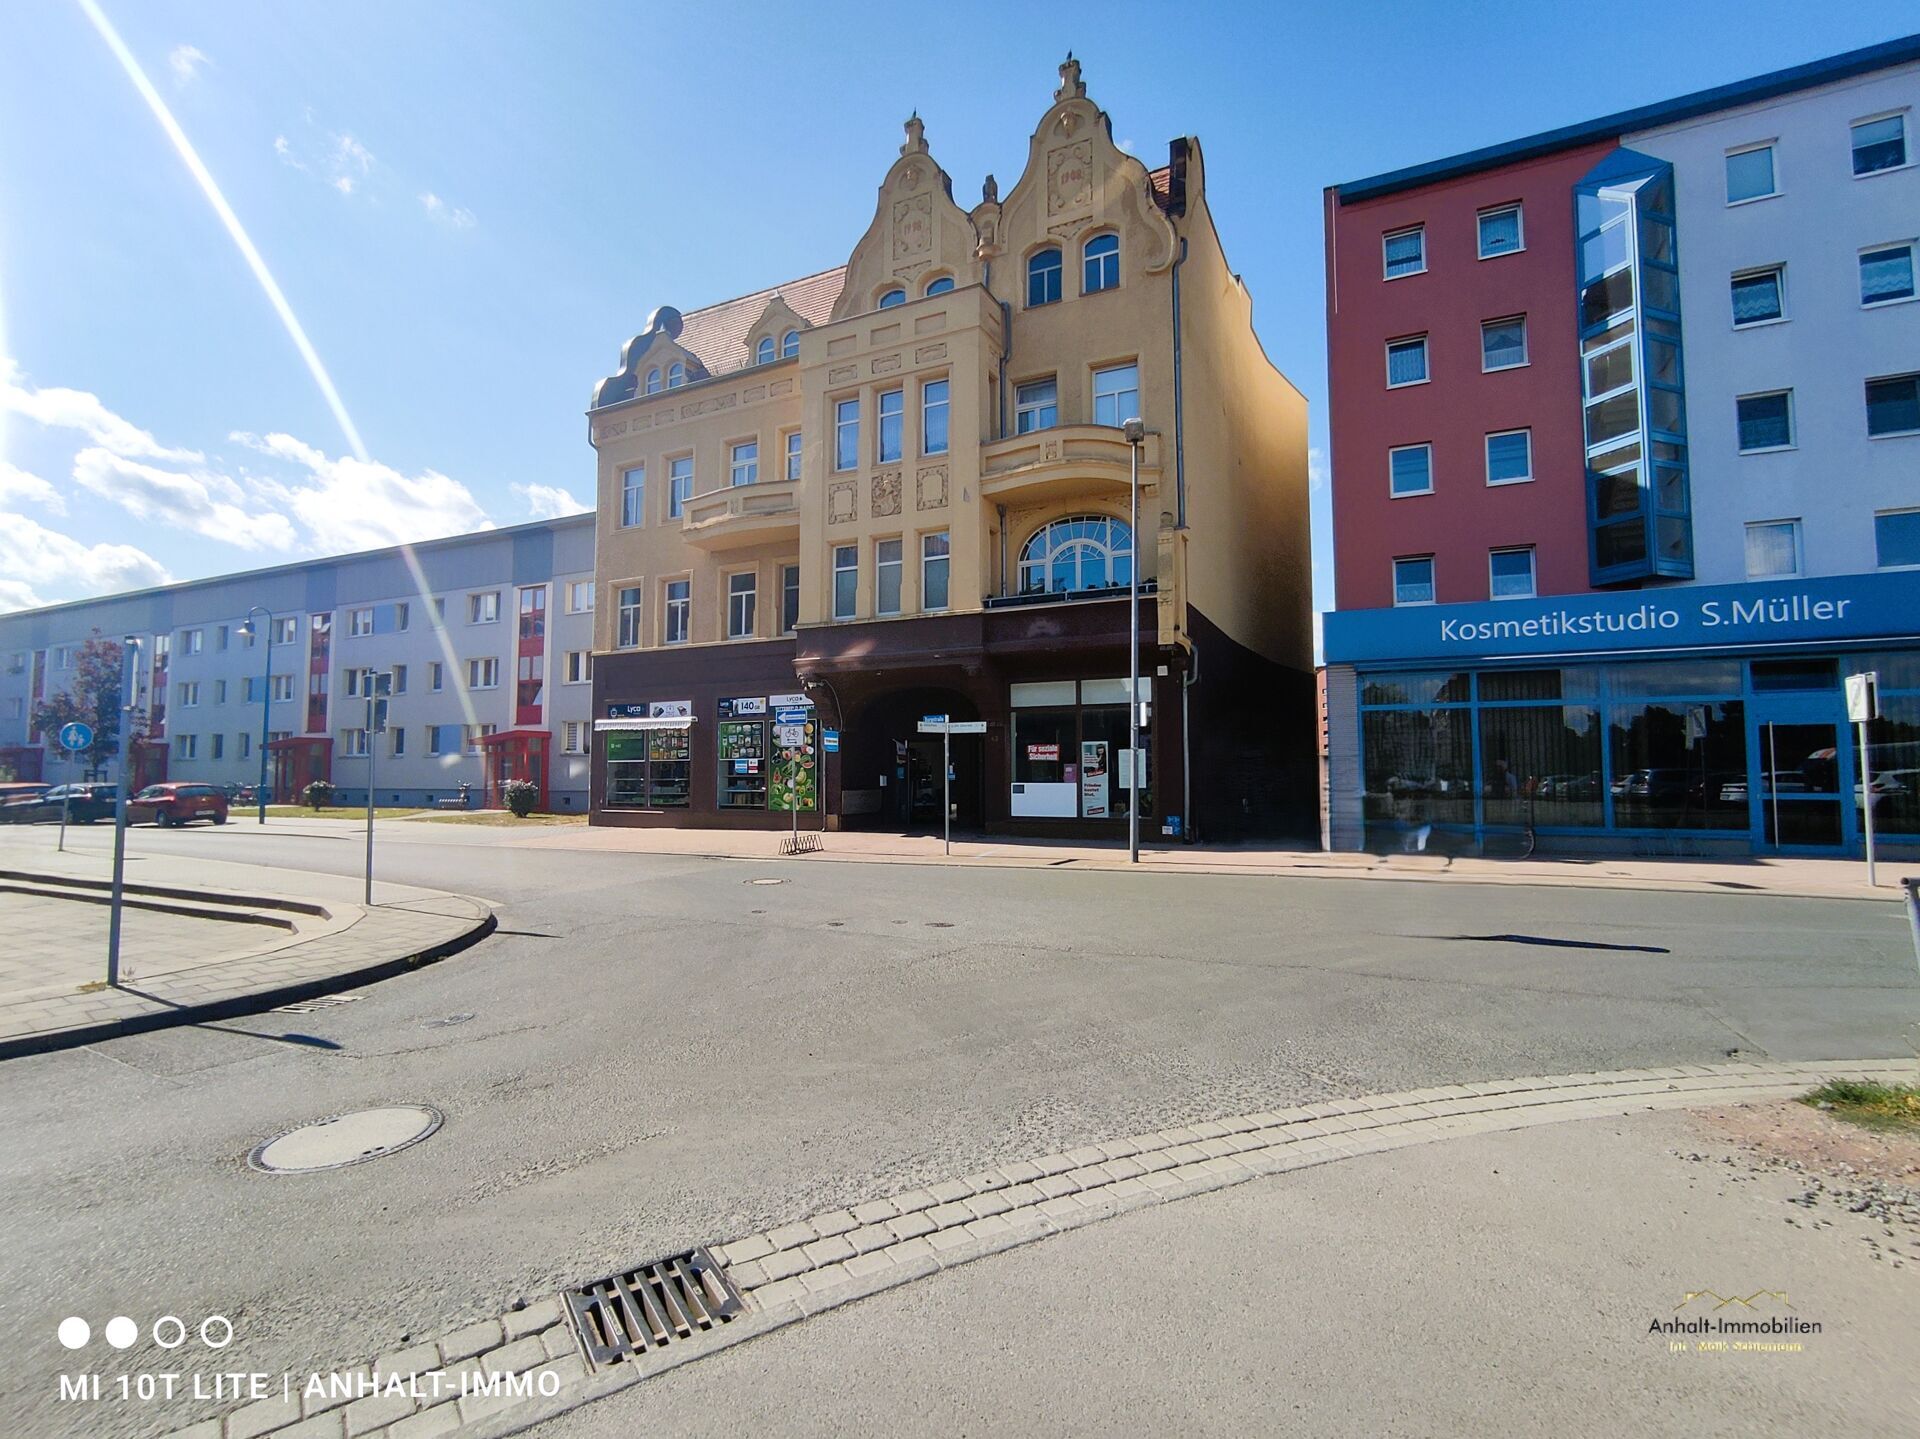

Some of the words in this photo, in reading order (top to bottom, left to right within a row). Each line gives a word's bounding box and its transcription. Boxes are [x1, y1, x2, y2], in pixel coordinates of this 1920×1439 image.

[1440, 603, 1679, 642] Kosmetikstudio
[1701, 595, 1851, 627] S.Müller
[627, 705, 641, 713] Lyca
[740, 702, 755, 711] 140
